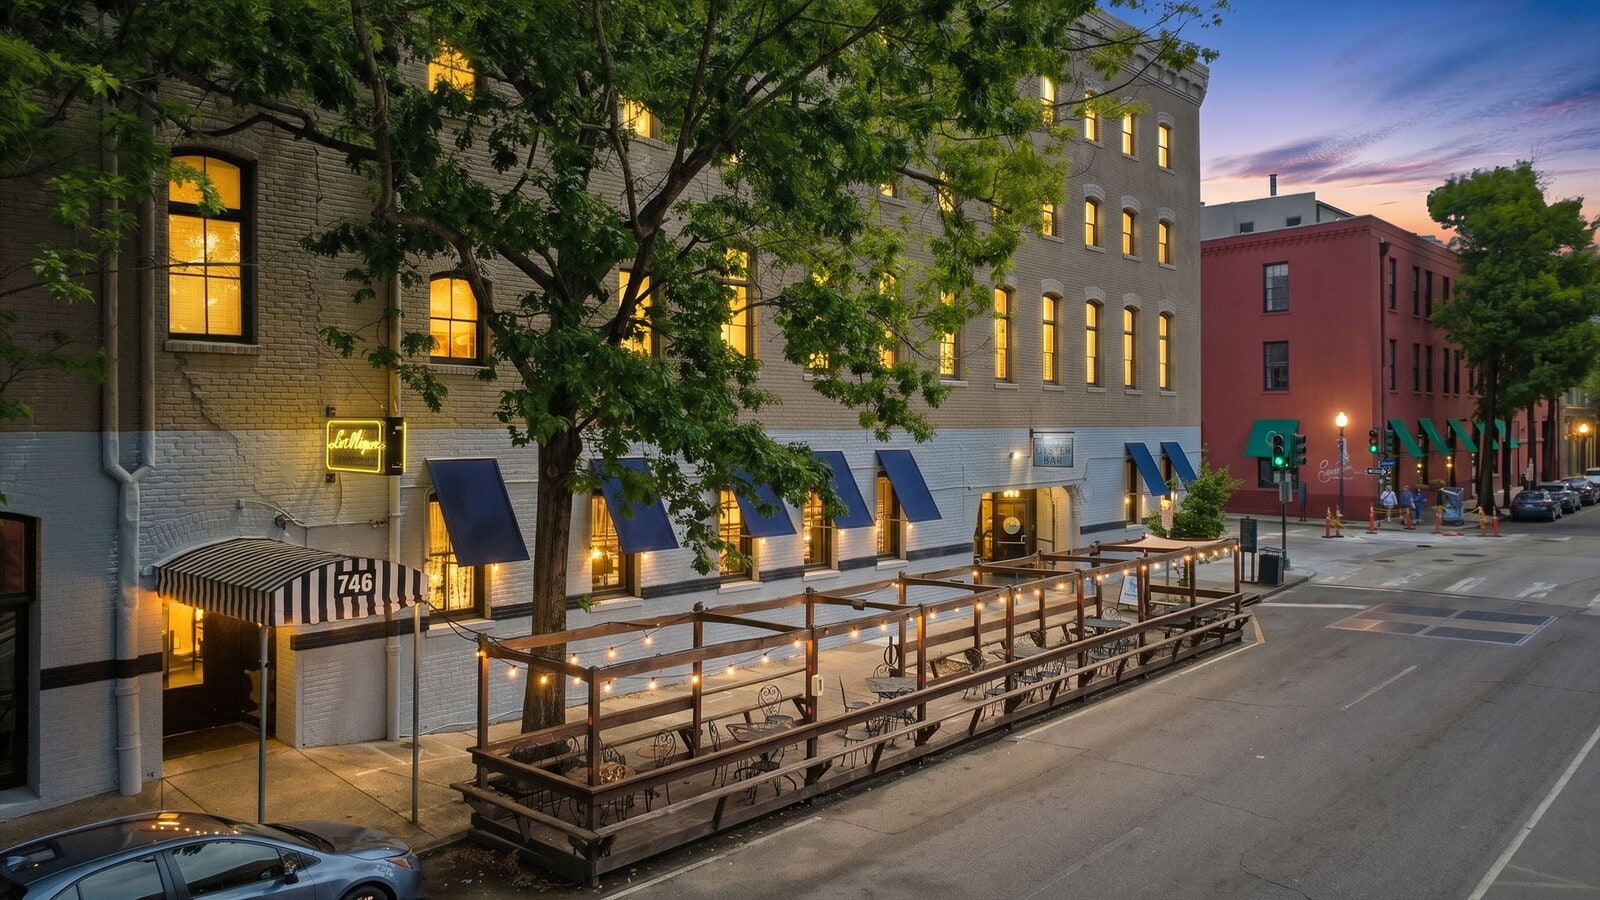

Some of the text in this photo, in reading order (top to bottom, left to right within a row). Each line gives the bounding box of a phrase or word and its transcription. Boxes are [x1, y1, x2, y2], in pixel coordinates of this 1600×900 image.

[1035, 446, 1071, 456] OYSTER
[1043, 456, 1062, 465] BAR
[337, 572, 373, 594] 746
